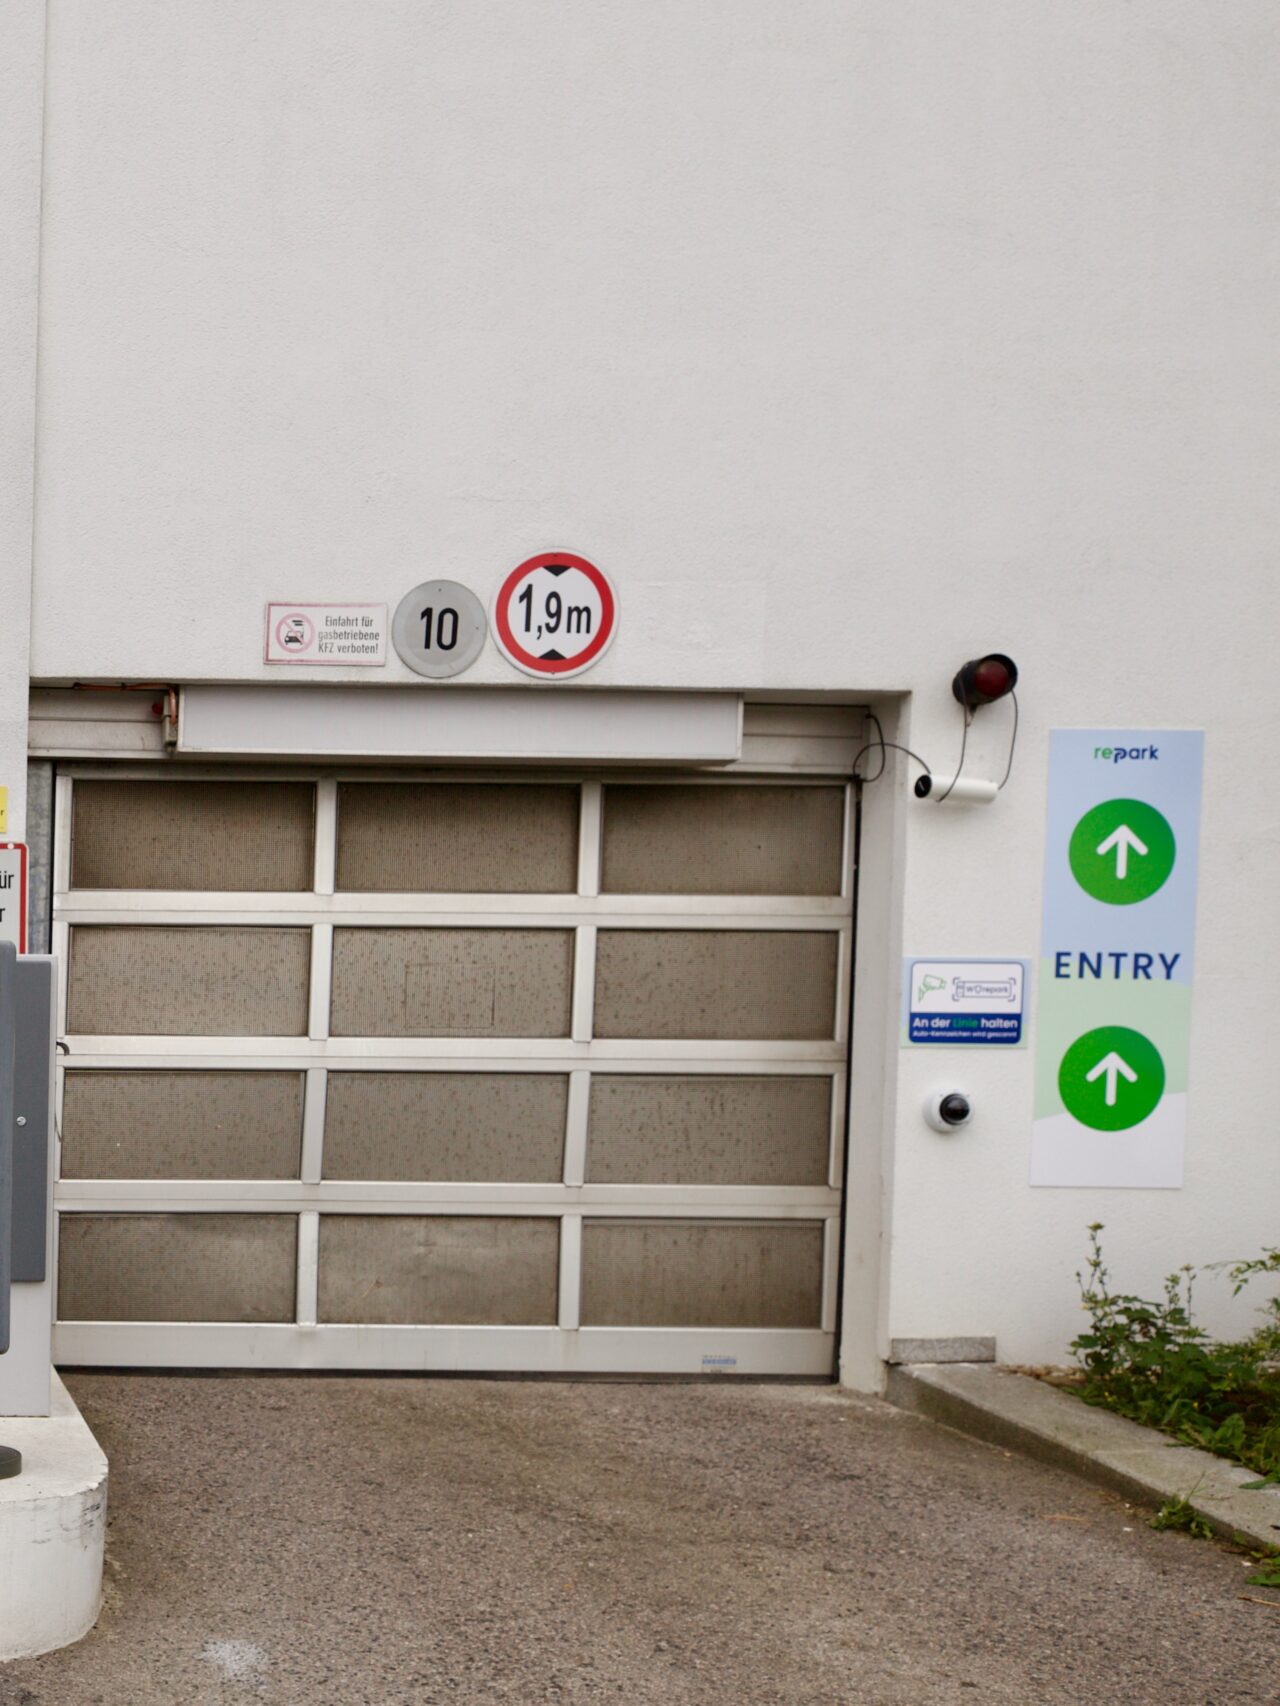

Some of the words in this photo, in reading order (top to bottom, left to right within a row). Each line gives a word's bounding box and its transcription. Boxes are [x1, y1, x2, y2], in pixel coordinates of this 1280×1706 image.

[325, 615, 358, 627] Einfahrt
[361, 616, 374, 627] für
[420, 607, 459, 650] 10
[318, 630, 380, 641] gasbetriebene
[318, 642, 334, 653] KFZ
[337, 643, 379, 654] verboten!
[1093, 744, 1159, 763] repark
[1054, 951, 1181, 980] ENTRY
[912, 1017, 929, 1028] An
[930, 1017, 951, 1028] der
[953, 1017, 977, 1028] Linie
[981, 1017, 1018, 1028] halten
